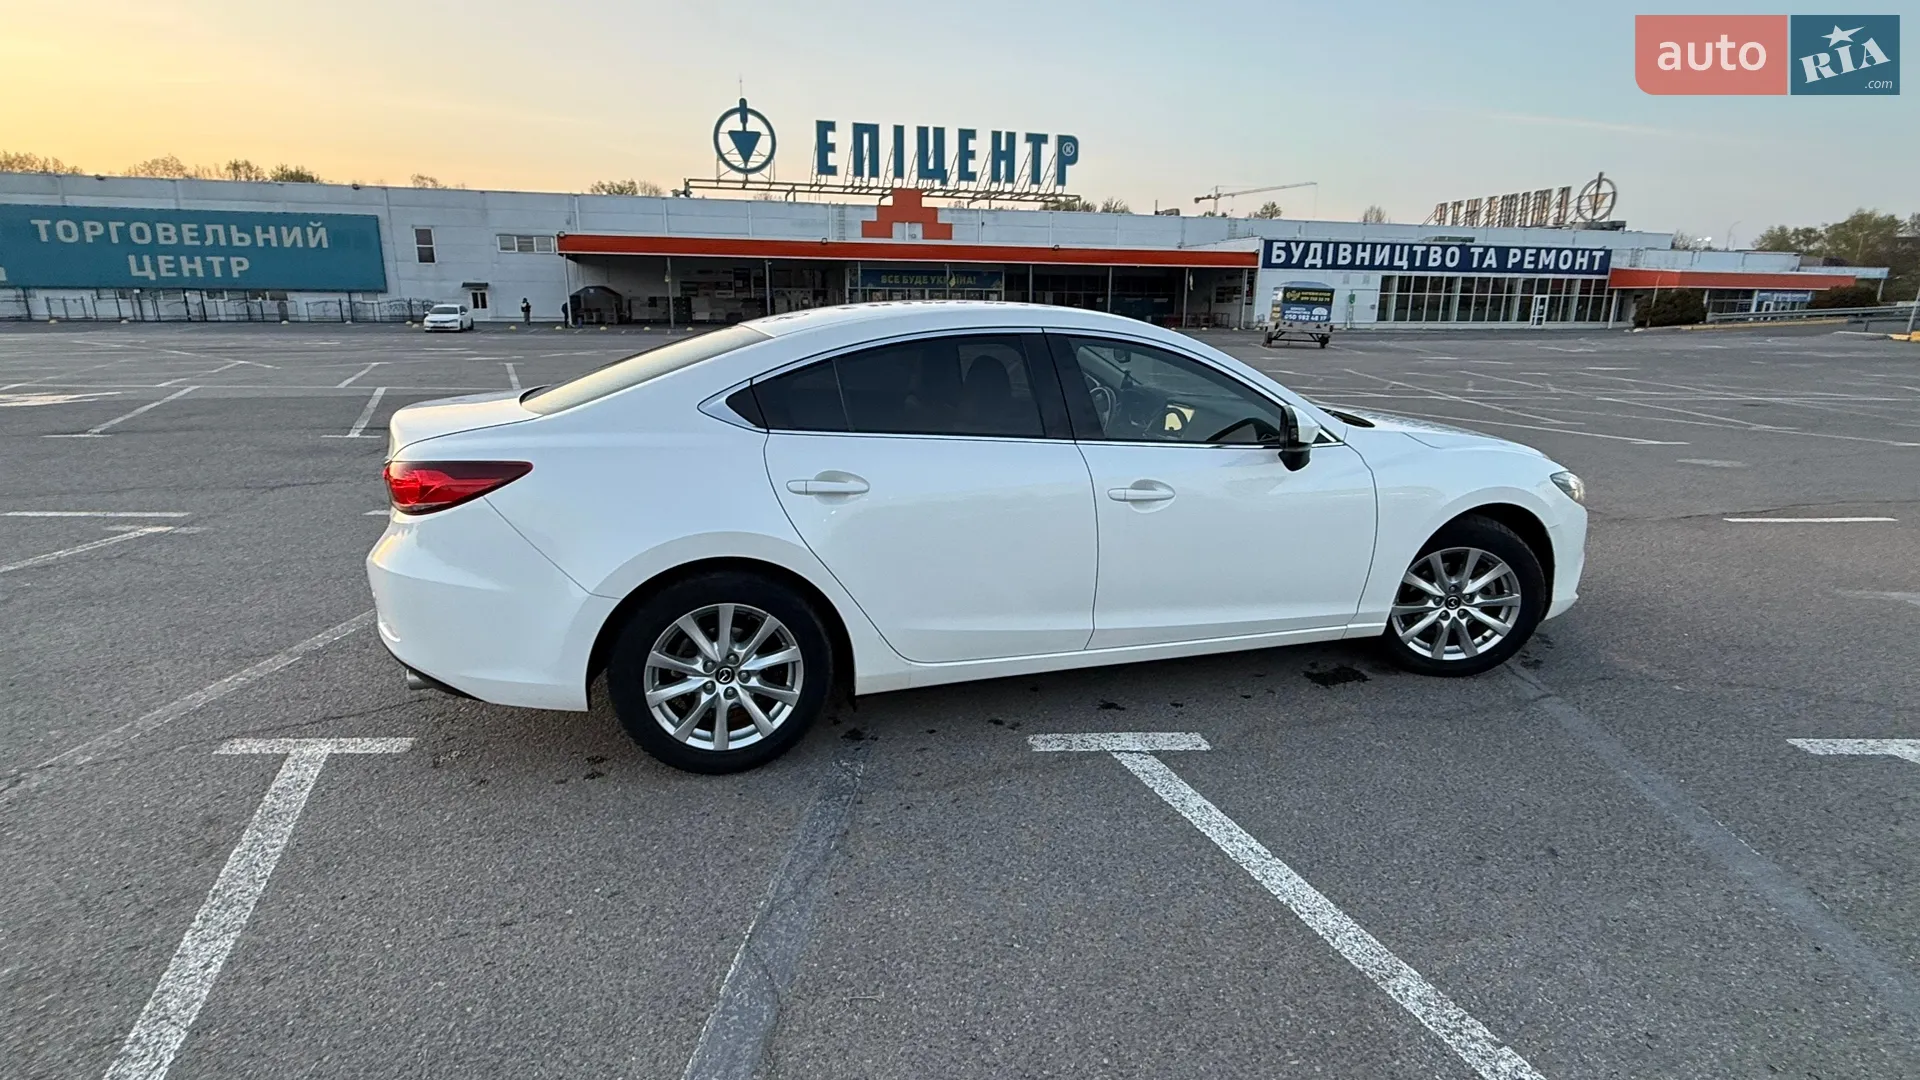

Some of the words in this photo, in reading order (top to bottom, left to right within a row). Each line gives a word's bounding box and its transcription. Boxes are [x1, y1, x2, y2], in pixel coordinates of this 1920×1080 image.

[815, 121, 1079, 186] ЕПІЦЕНТР
[30, 219, 329, 248] ТОРГОВЕЛЬНИЙ
[128, 255, 250, 281] ЦЕНТР
[1270, 241, 1461, 270] БУДІВНИЦТВО
[1470, 246, 1498, 269] ТА
[1507, 248, 1606, 271] РЕМОНТ
[880, 274, 900, 284] ВСЕ
[902, 275, 928, 285] БУДЕ
[931, 275, 976, 286] УКРЇНА!
